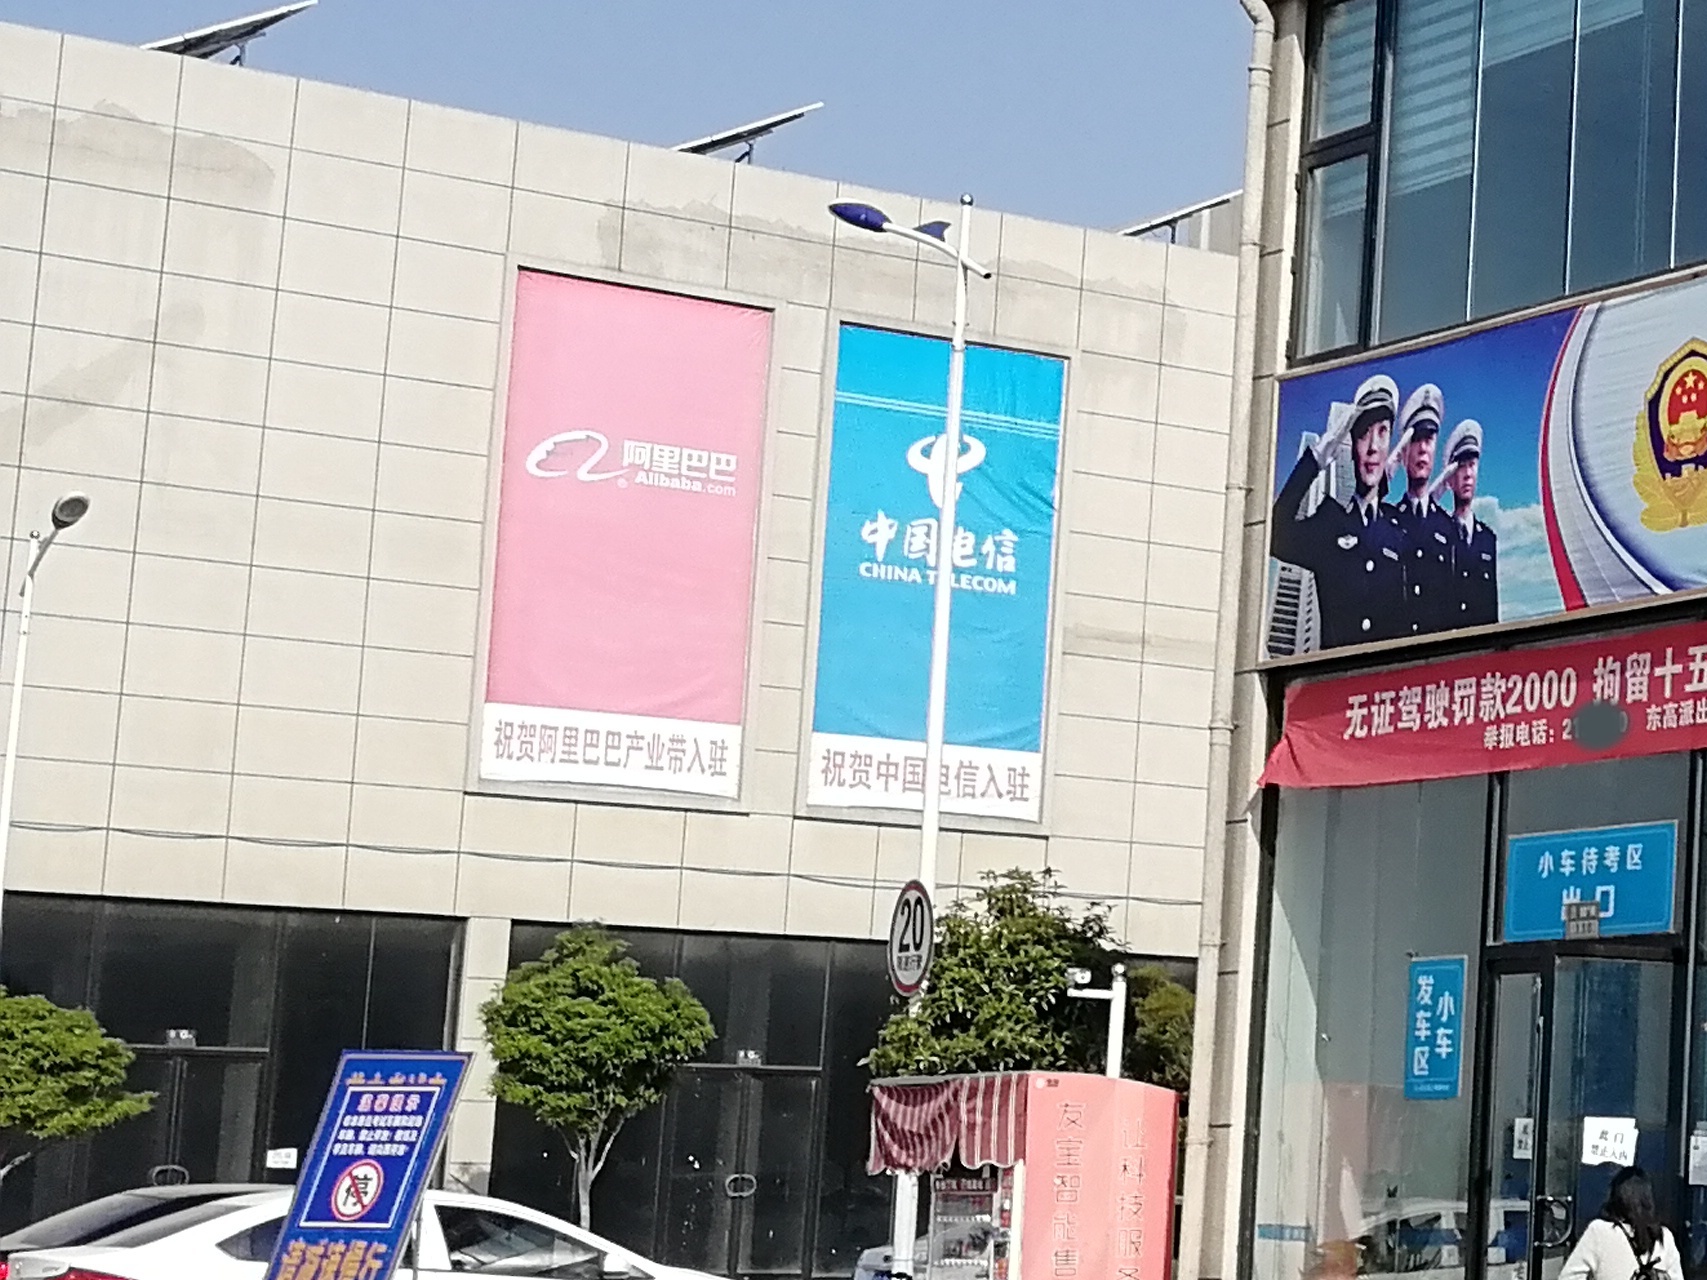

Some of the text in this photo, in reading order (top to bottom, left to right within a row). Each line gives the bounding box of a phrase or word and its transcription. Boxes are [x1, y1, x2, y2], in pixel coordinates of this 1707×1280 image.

[622, 439, 738, 483] 阿里巴巴
[634, 471, 737, 497] Alibaba.com
[860, 508, 1019, 573] 中国电信
[858, 562, 1017, 595] CHINA TLECOM
[1342, 667, 1578, 740] 无证驾驶罚款2000
[493, 719, 729, 777] 祝贺阿里巴巴产业带入驻
[1537, 842, 1643, 880] 小车待考区
[898, 895, 924, 953] 20
[1412, 974, 1434, 1076] 发车区
[1434, 990, 1455, 1060] 小车
